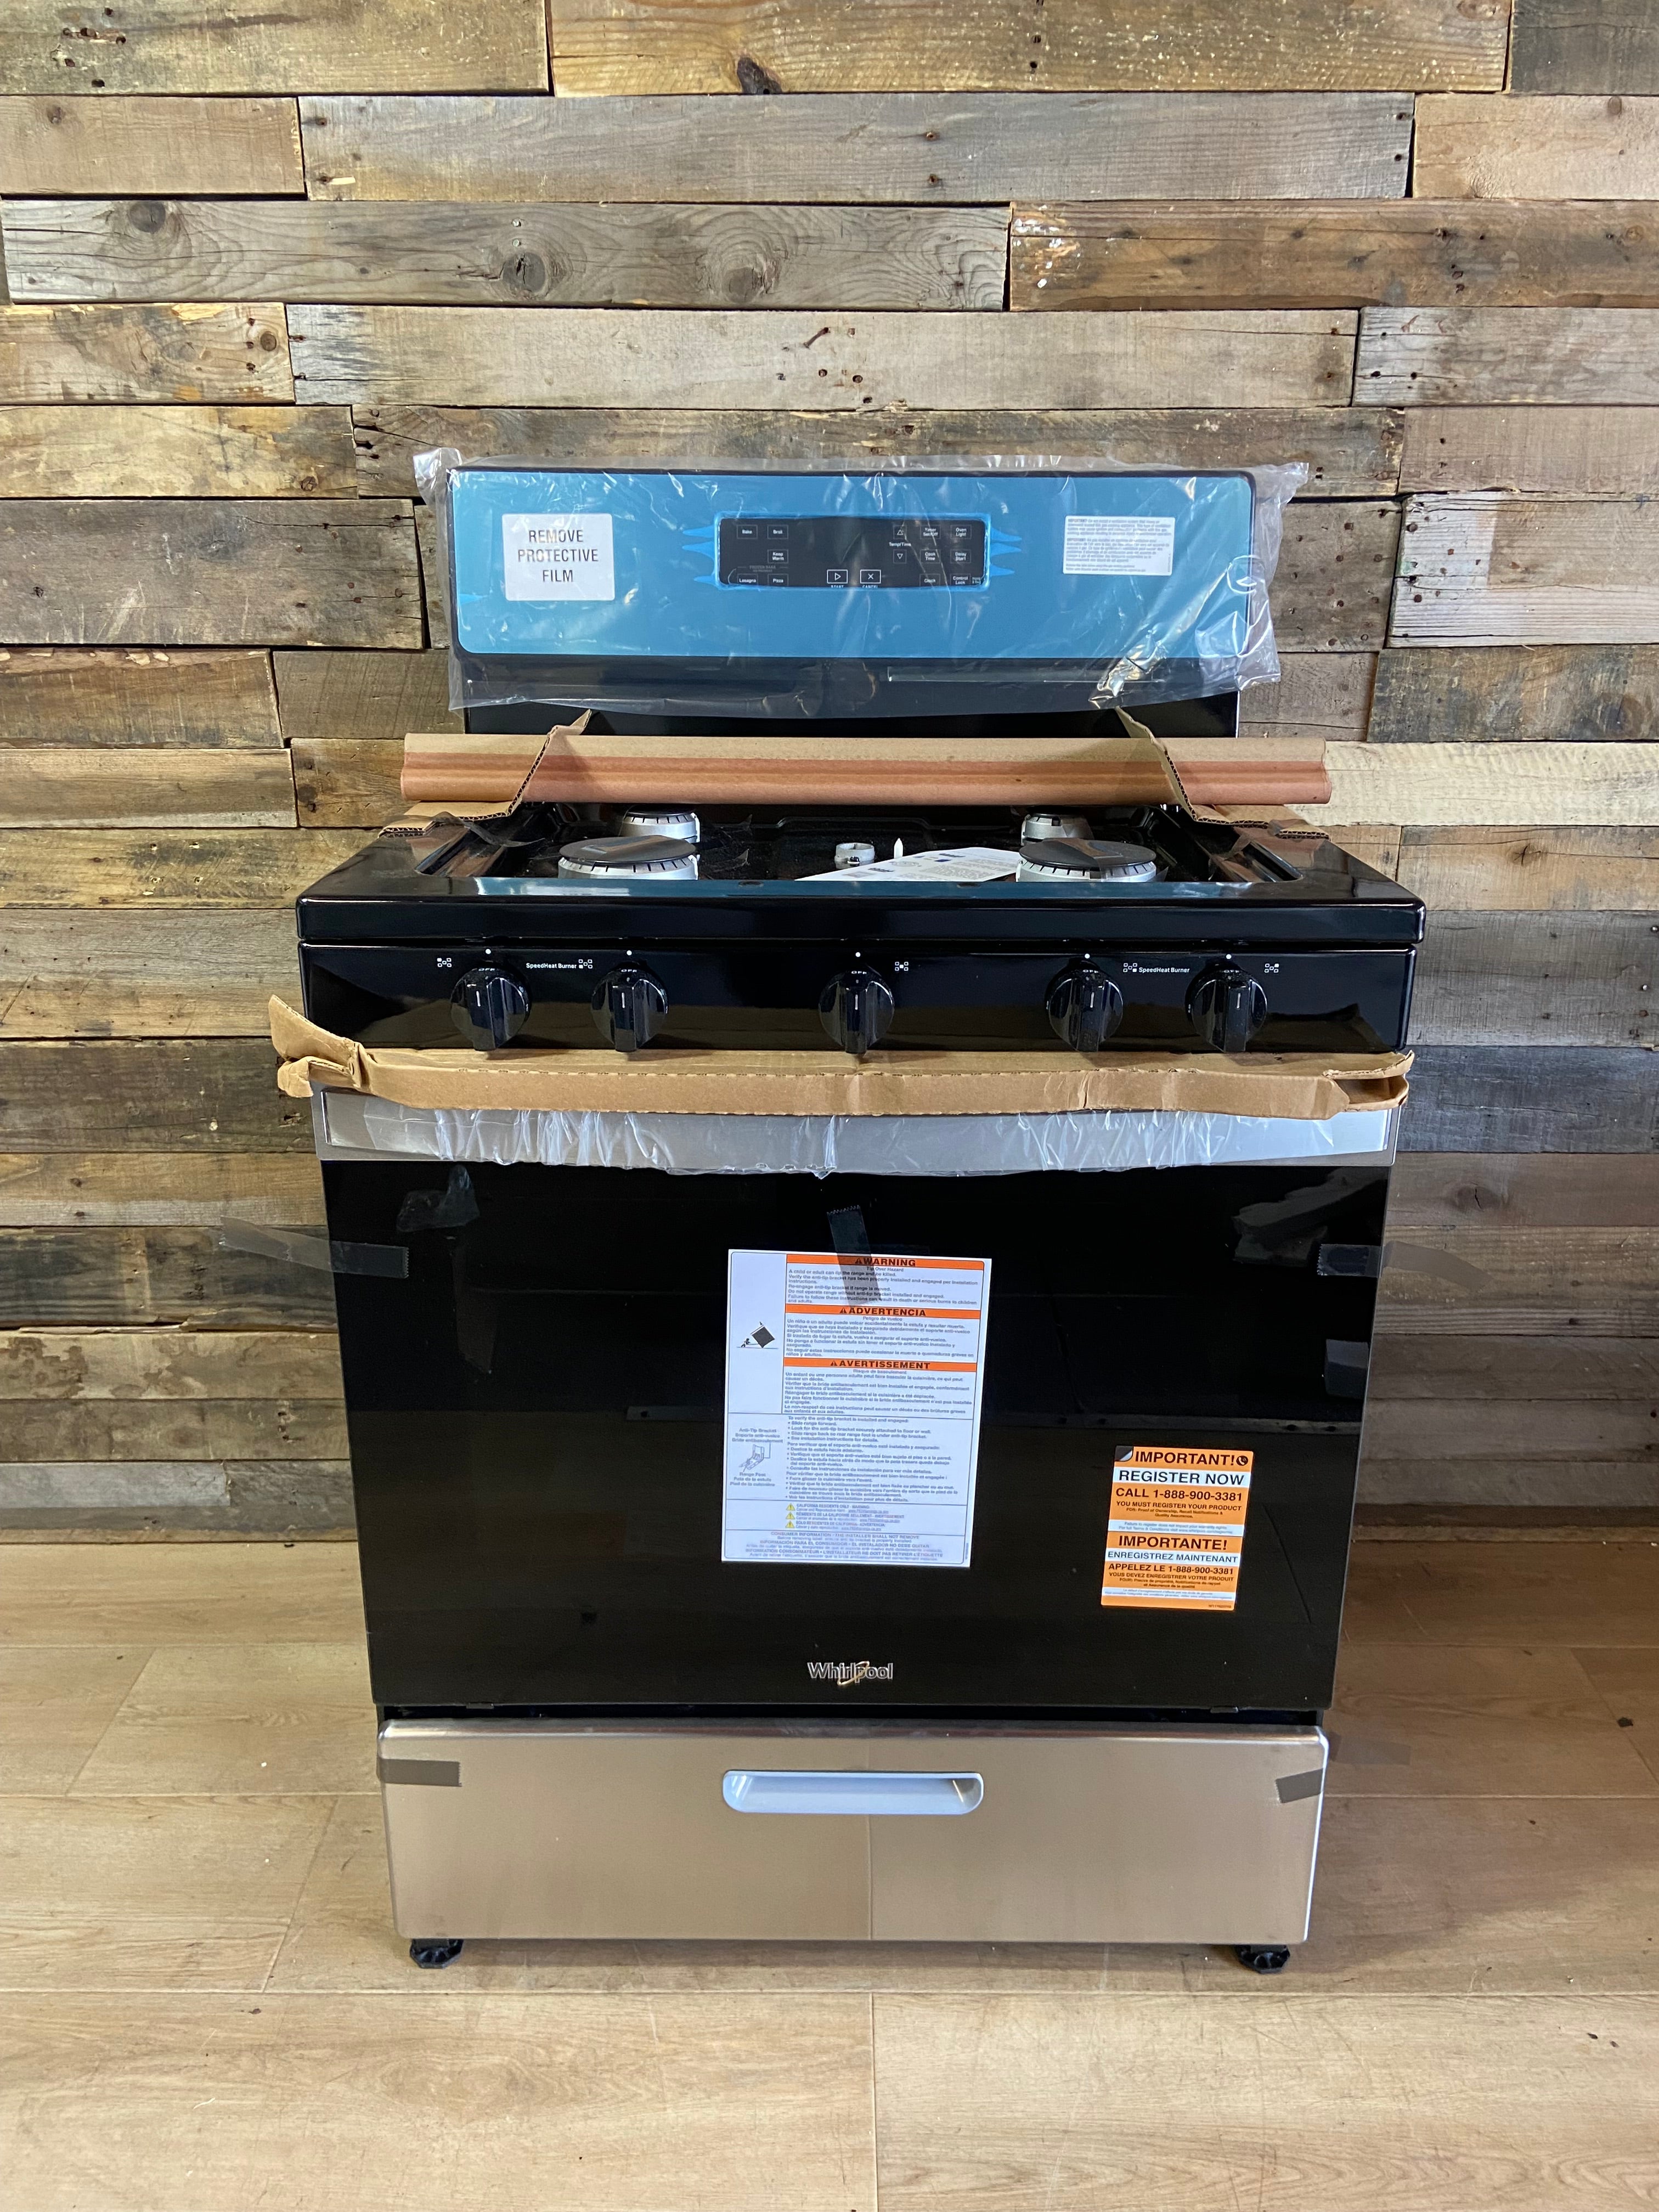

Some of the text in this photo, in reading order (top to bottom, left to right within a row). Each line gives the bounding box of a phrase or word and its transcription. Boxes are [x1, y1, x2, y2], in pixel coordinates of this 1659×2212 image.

[528, 529, 583, 543] REMOVE
[518, 549, 599, 562] PROTECTIVE
[543, 569, 573, 582] FILM
[864, 1257, 916, 1266] WARNING
[849, 1307, 926, 1316] ADVERTENCIA
[839, 1359, 930, 1369] AVERTISSEMENT
[1135, 1451, 1234, 1466] IMPORTANT!
[1119, 1469, 1244, 1486] REGISTER NOW
[1115, 1487, 1243, 1502] CALL 1-888-900-3381
[1119, 1535, 1227, 1550] IMPORTANTE!
[1108, 1551, 1238, 1563] ENREGISTREZ MAINTENANT
[1108, 1562, 1151, 1571] APPELEZ
[1167, 1565, 1234, 1575] 1-888-900-3381
[807, 1661, 893, 1685] Whirlpool
